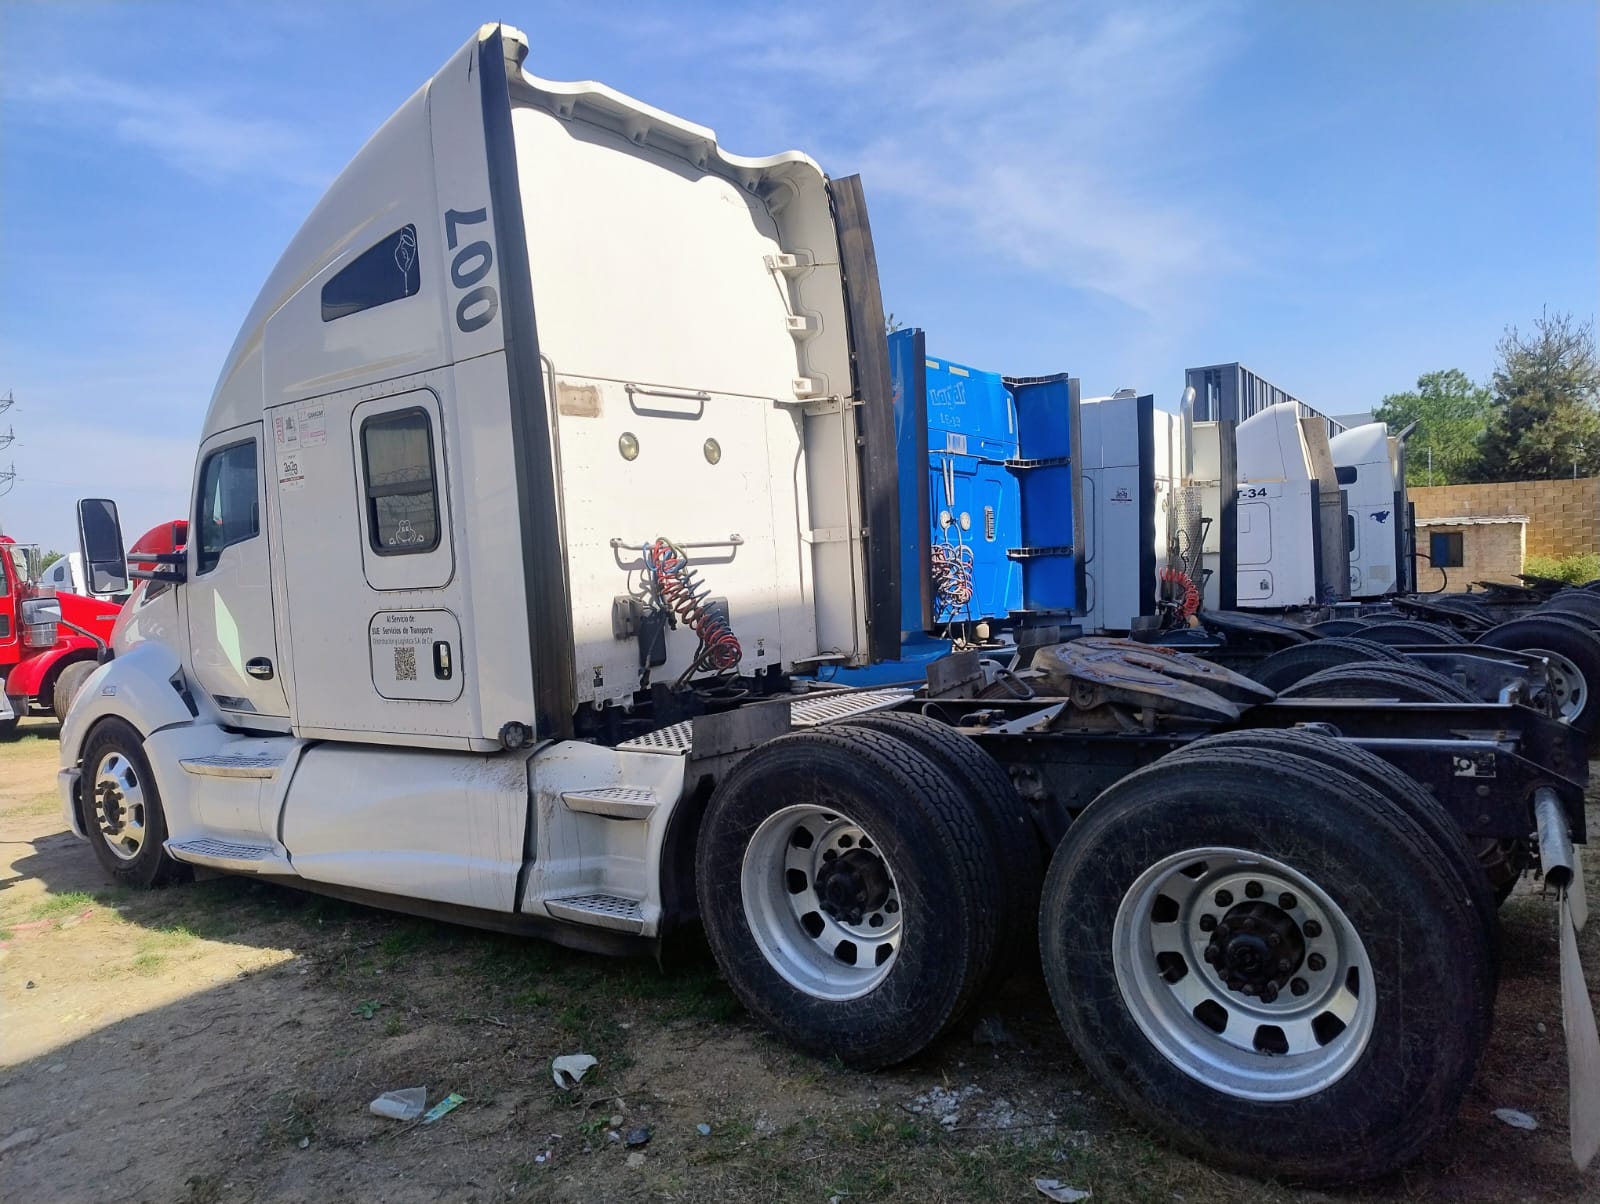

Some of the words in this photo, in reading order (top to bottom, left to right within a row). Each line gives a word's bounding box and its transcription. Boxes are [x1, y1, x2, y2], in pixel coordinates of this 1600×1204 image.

[444, 207, 498, 332] 007
[391, 615, 409, 623] Servicio
[382, 626, 401, 635] Servicios
[403, 626, 408, 635] de
[410, 626, 433, 636] Transporte
